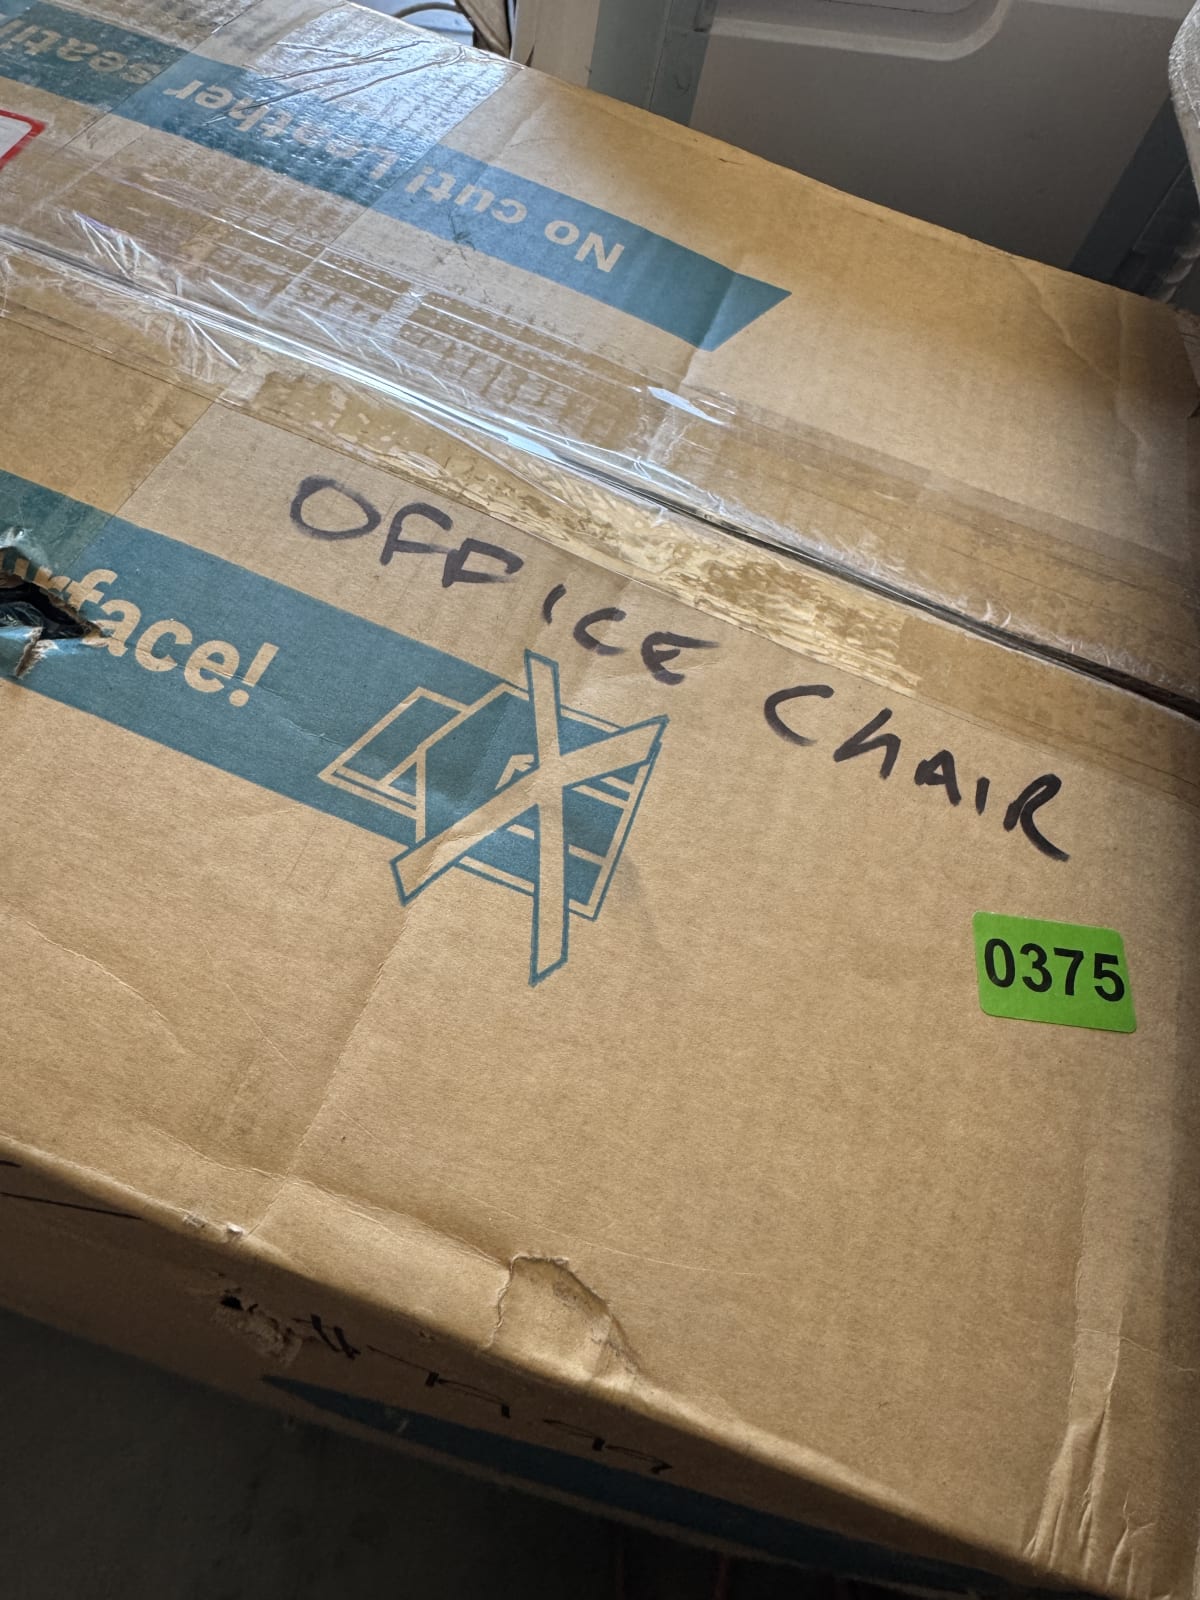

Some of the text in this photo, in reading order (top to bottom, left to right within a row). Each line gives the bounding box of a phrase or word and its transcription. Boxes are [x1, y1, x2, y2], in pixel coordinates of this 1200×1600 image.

[405, 167, 528, 223] cut!
[545, 220, 625, 273] No
[984, 938, 1125, 1002] 0375
